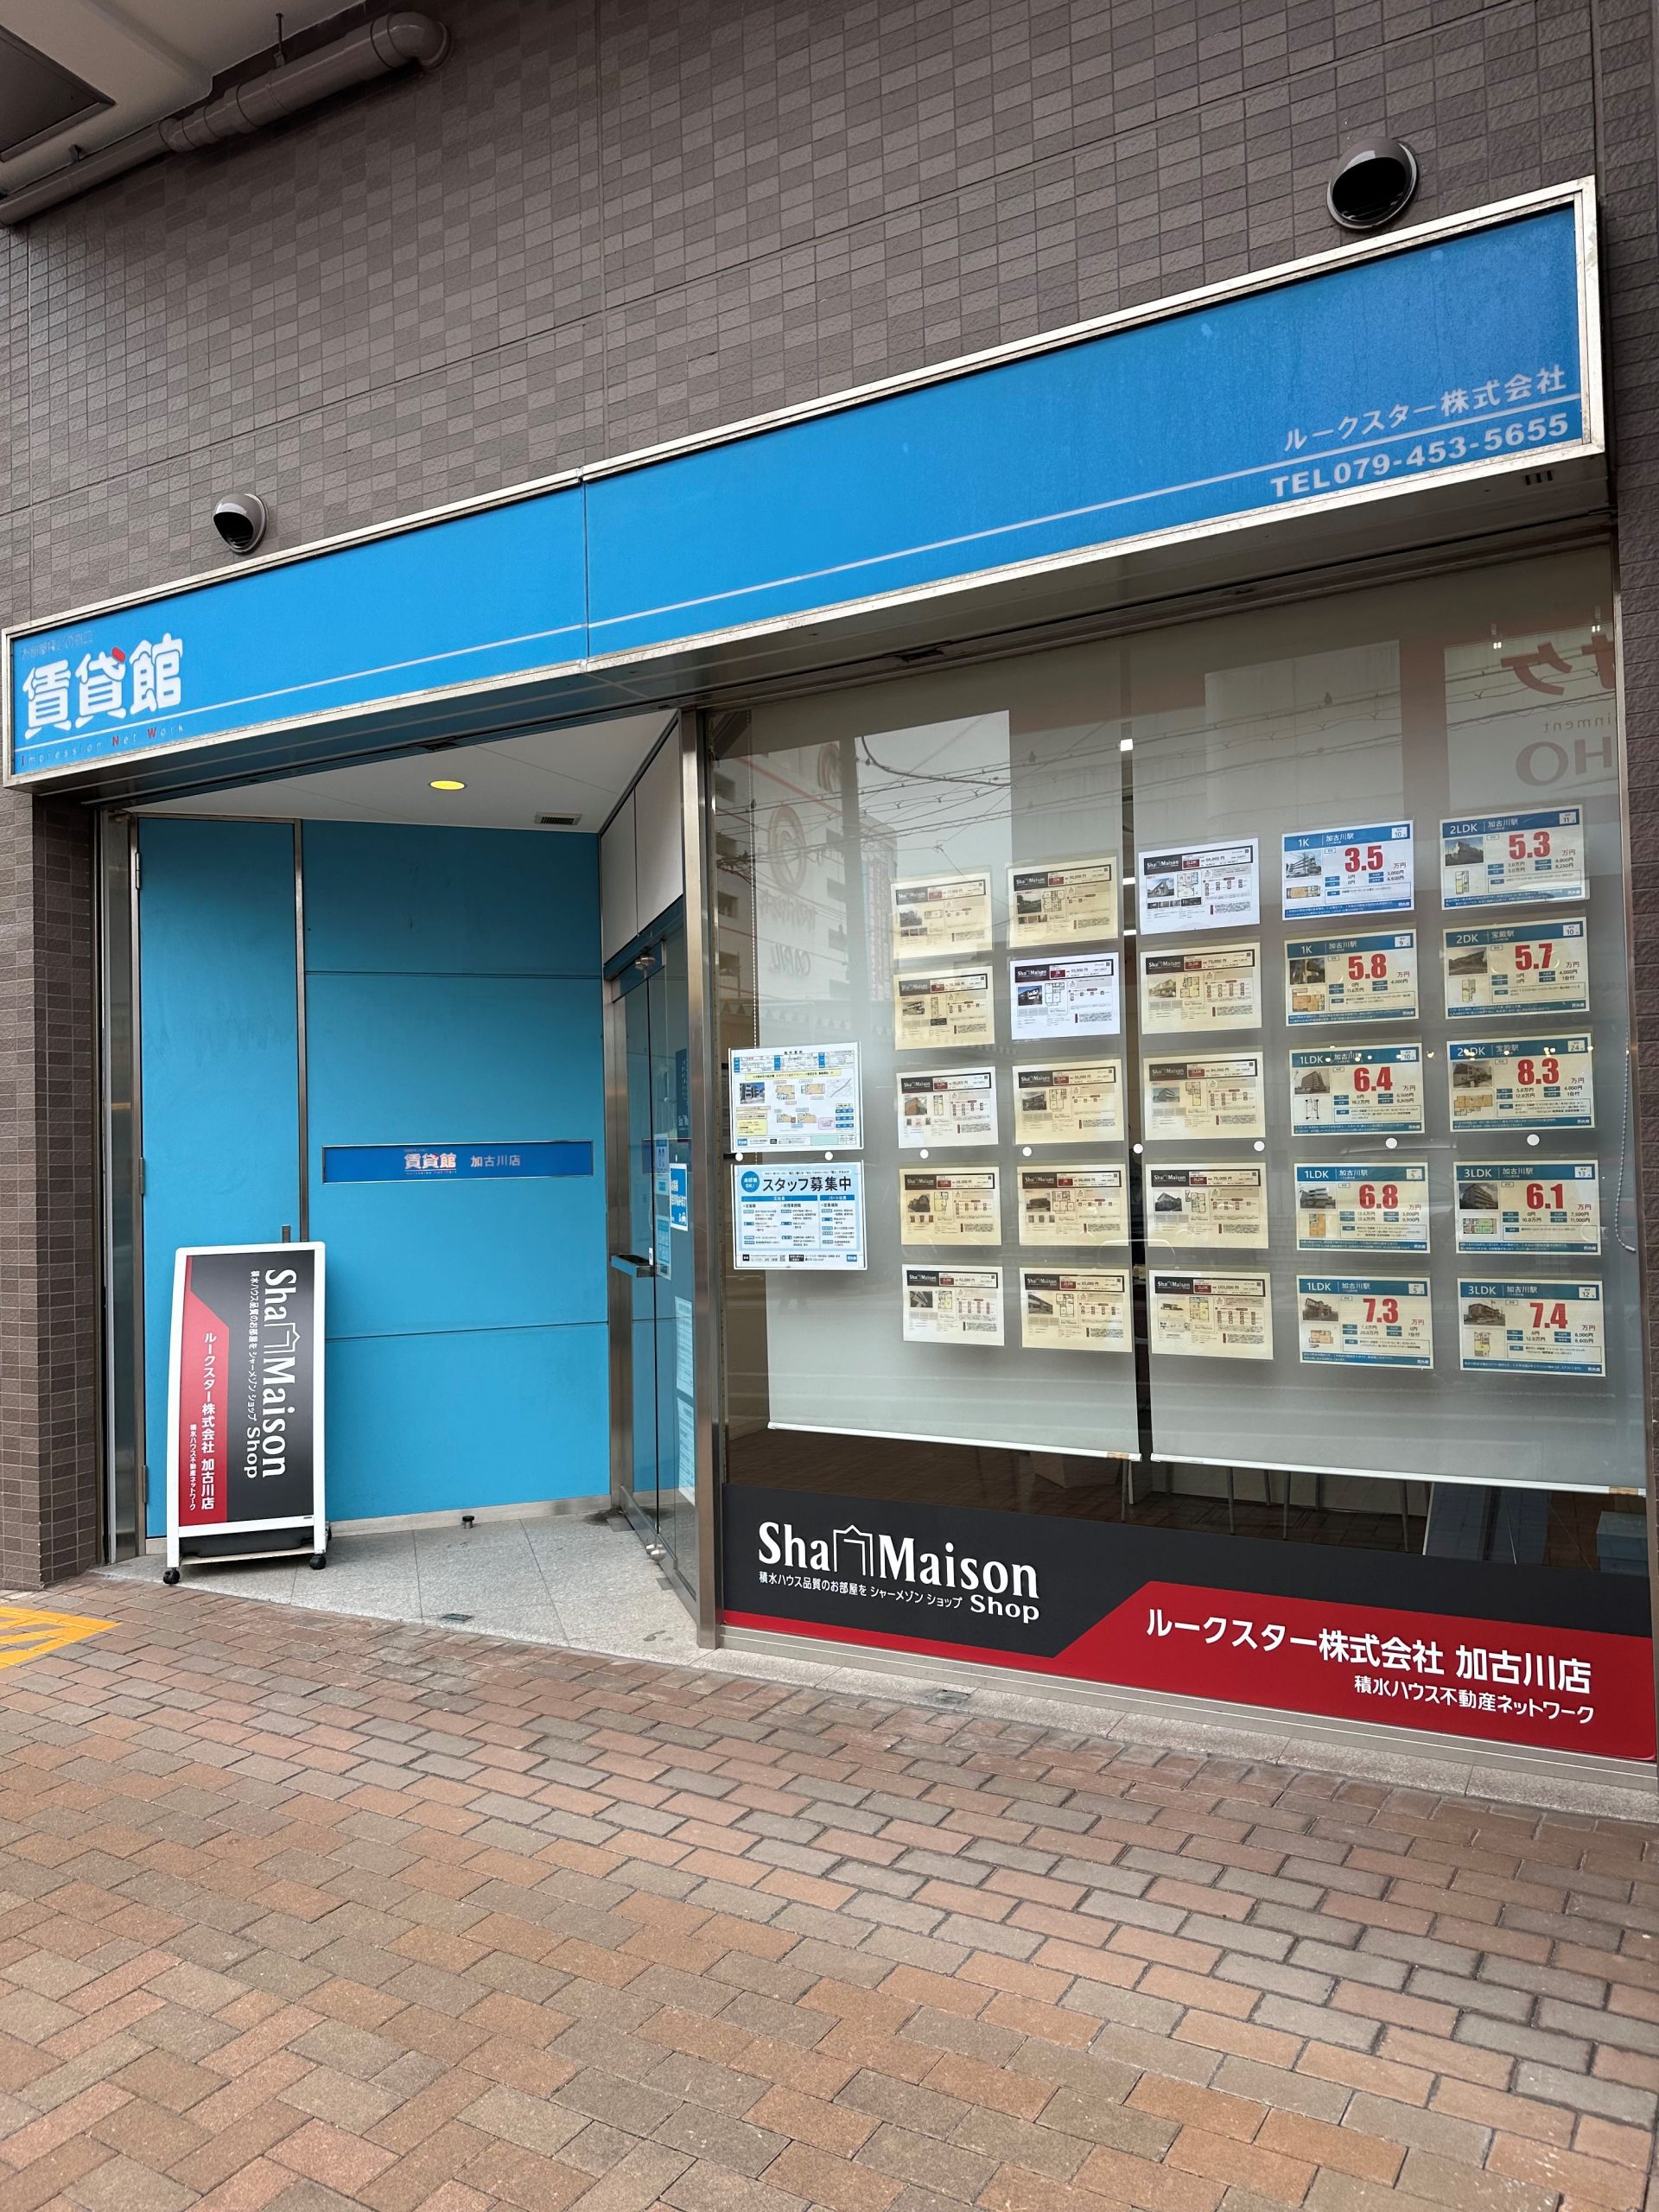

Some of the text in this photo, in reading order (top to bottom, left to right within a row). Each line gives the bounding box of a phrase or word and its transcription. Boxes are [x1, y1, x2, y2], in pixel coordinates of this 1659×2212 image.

[1284, 365, 1567, 452] ルークスター株式会社
[1270, 412, 1568, 499] TEL079-453-5655
[22, 632, 183, 740] 賃貸館
[21, 722, 184, 766] Impression Net Work
[1450, 823, 1478, 834] 2LDK
[1344, 845, 1383, 872] 3.5
[1509, 831, 1550, 859] 5.3
[1457, 934, 1478, 944] 2DK
[1349, 953, 1387, 980] 5.8
[1515, 943, 1552, 970] 5.7
[1300, 1056, 1323, 1065] 1LDK
[1517, 1058, 1559, 1085] 8.3
[1354, 1067, 1392, 1092] 6.4
[404, 1152, 521, 1170] 賃貸館 加古川店
[1305, 1170, 1329, 1179] 1LDK
[1465, 1168, 1492, 1178] 3LDK
[763, 1176, 851, 1192] スタッフ募集中
[1359, 1185, 1398, 1209] 6.8
[1527, 1183, 1563, 1209] 6.1
[1307, 1282, 1331, 1291] 1LDK
[1469, 1286, 1497, 1294] 3LDK
[1363, 1299, 1398, 1324] 7.3
[1530, 1302, 1567, 1329] 7.4
[263, 1268, 297, 1478] Sha Maison
[200, 1332, 217, 1510] ルークスター株式会社 加古川店
[244, 1427, 261, 1478] Shop
[758, 1521, 1040, 1599] Sha Maison
[759, 1570, 963, 1610] 積水ハウス品質のお部屋を シャーメゾン ショップ
[970, 1594, 1040, 1624] Shop
[1146, 1608, 1592, 1694] ルークスター株式会社 加古川店
[1353, 1675, 1594, 1724] 積水ハウス不動産ネットワーク
